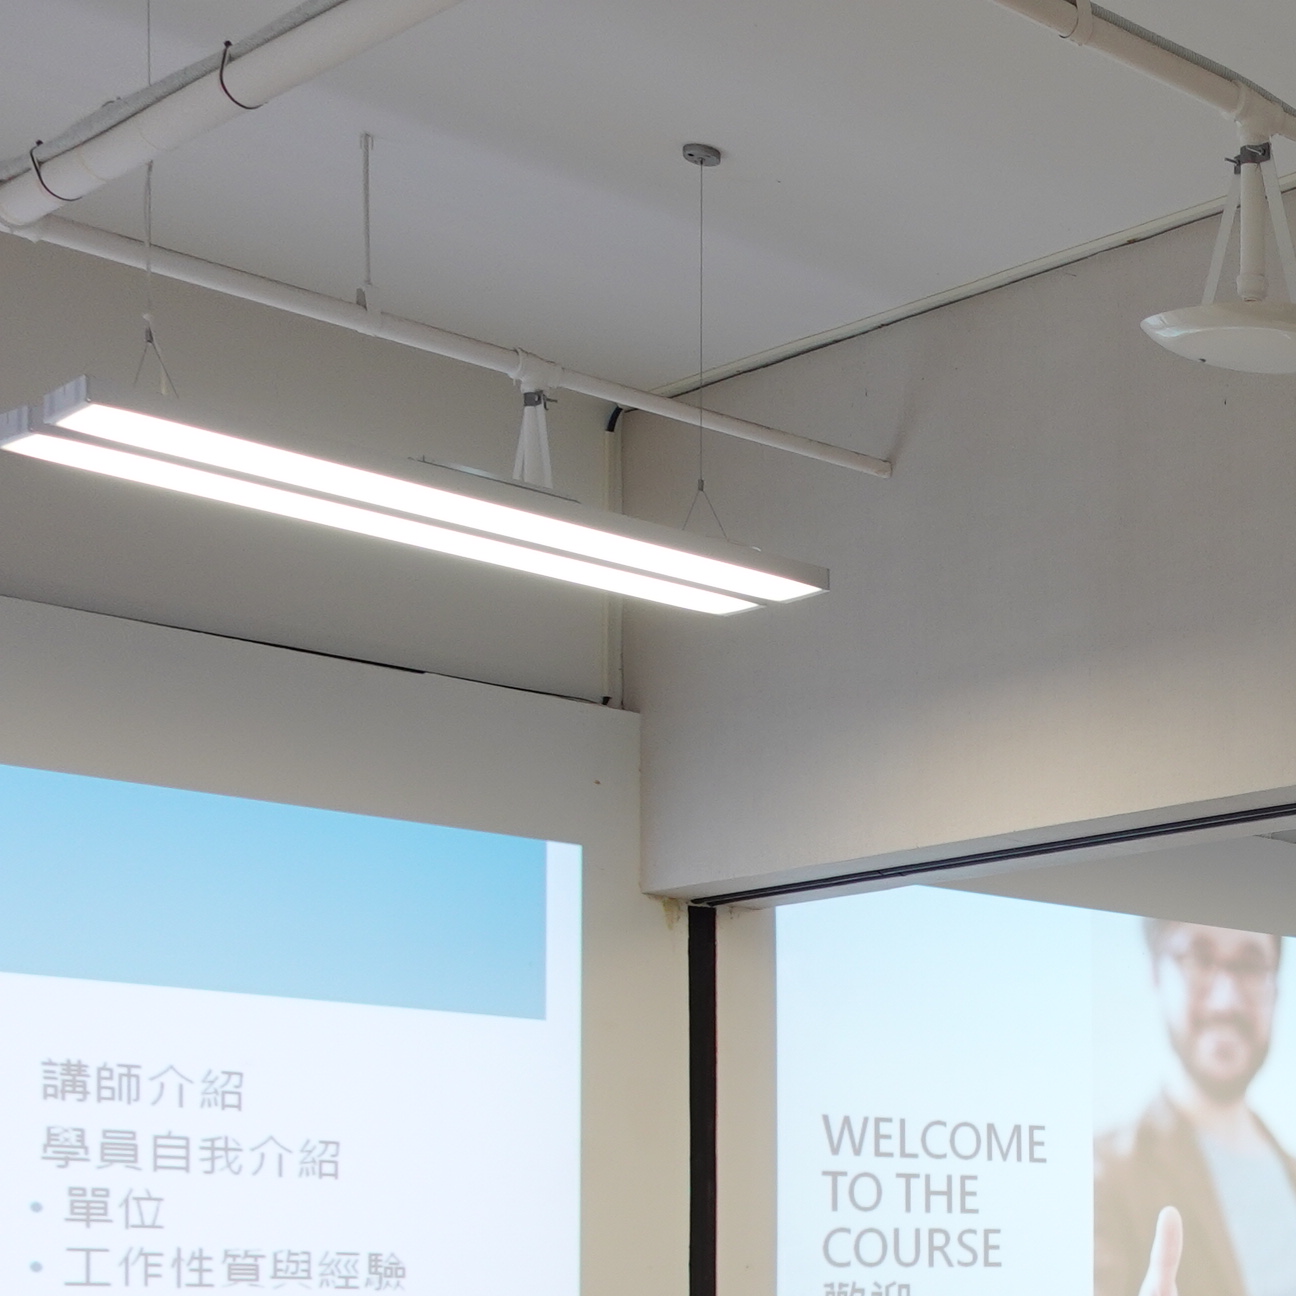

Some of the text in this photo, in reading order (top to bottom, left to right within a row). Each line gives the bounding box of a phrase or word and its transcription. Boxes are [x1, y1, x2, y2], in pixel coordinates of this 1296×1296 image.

[41, 1058, 244, 1112] 講師介紹
[41, 1125, 340, 1180] 學員自我介紹
[821, 1113, 1048, 1163] WELCOME
[63, 1186, 165, 1230] 單位
[821, 1170, 980, 1214] TO THE
[63, 1247, 407, 1292] 工作性質與經驗
[822, 1227, 1002, 1268] COURSE
